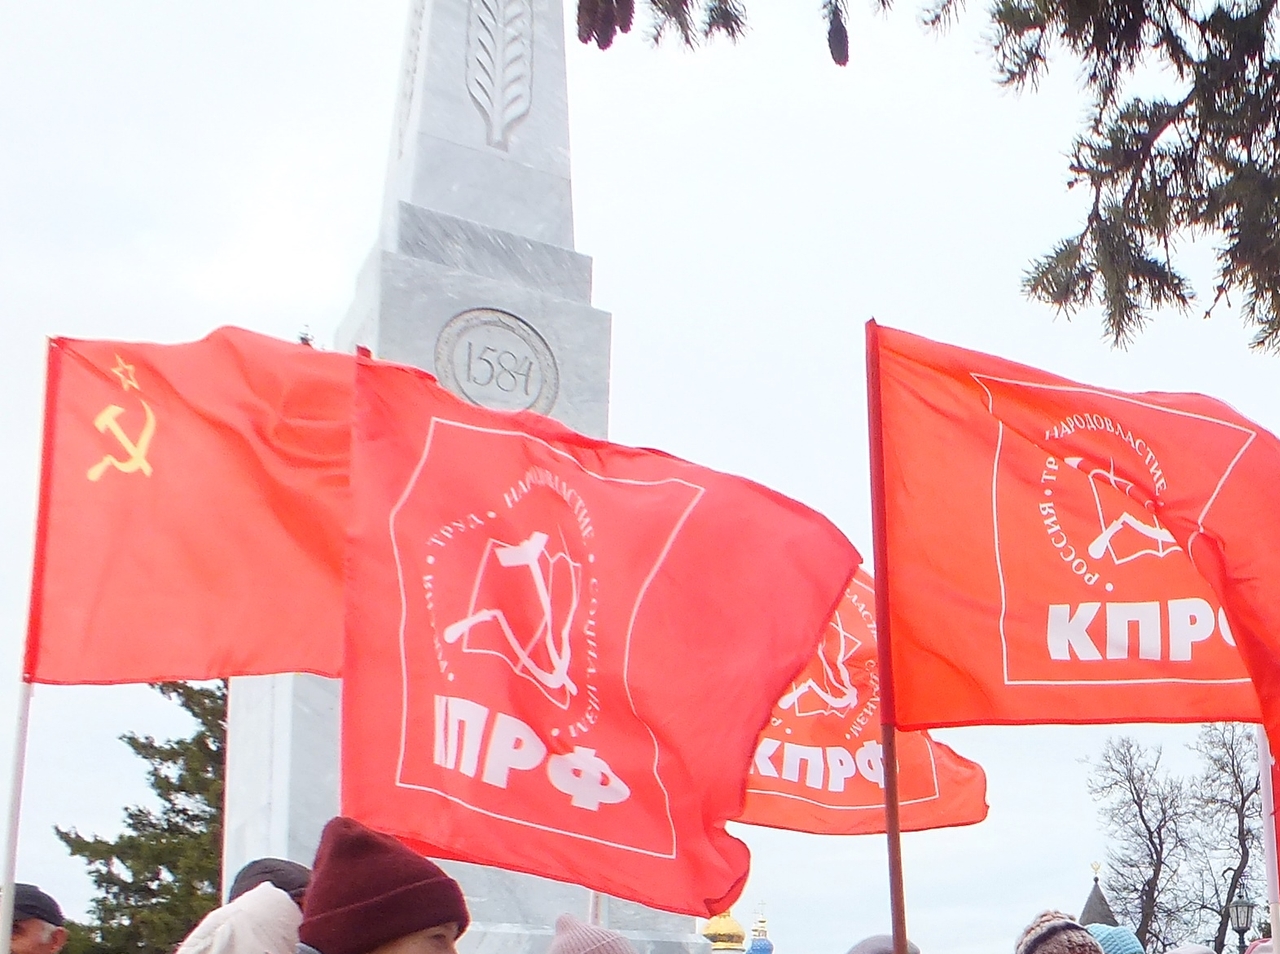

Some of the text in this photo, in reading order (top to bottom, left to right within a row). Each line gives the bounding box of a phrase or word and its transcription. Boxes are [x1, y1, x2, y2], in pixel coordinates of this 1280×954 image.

[466, 341, 533, 396] 1584
[1041, 456, 1059, 484] ТР
[1039, 501, 1100, 586] РОССИЯ
